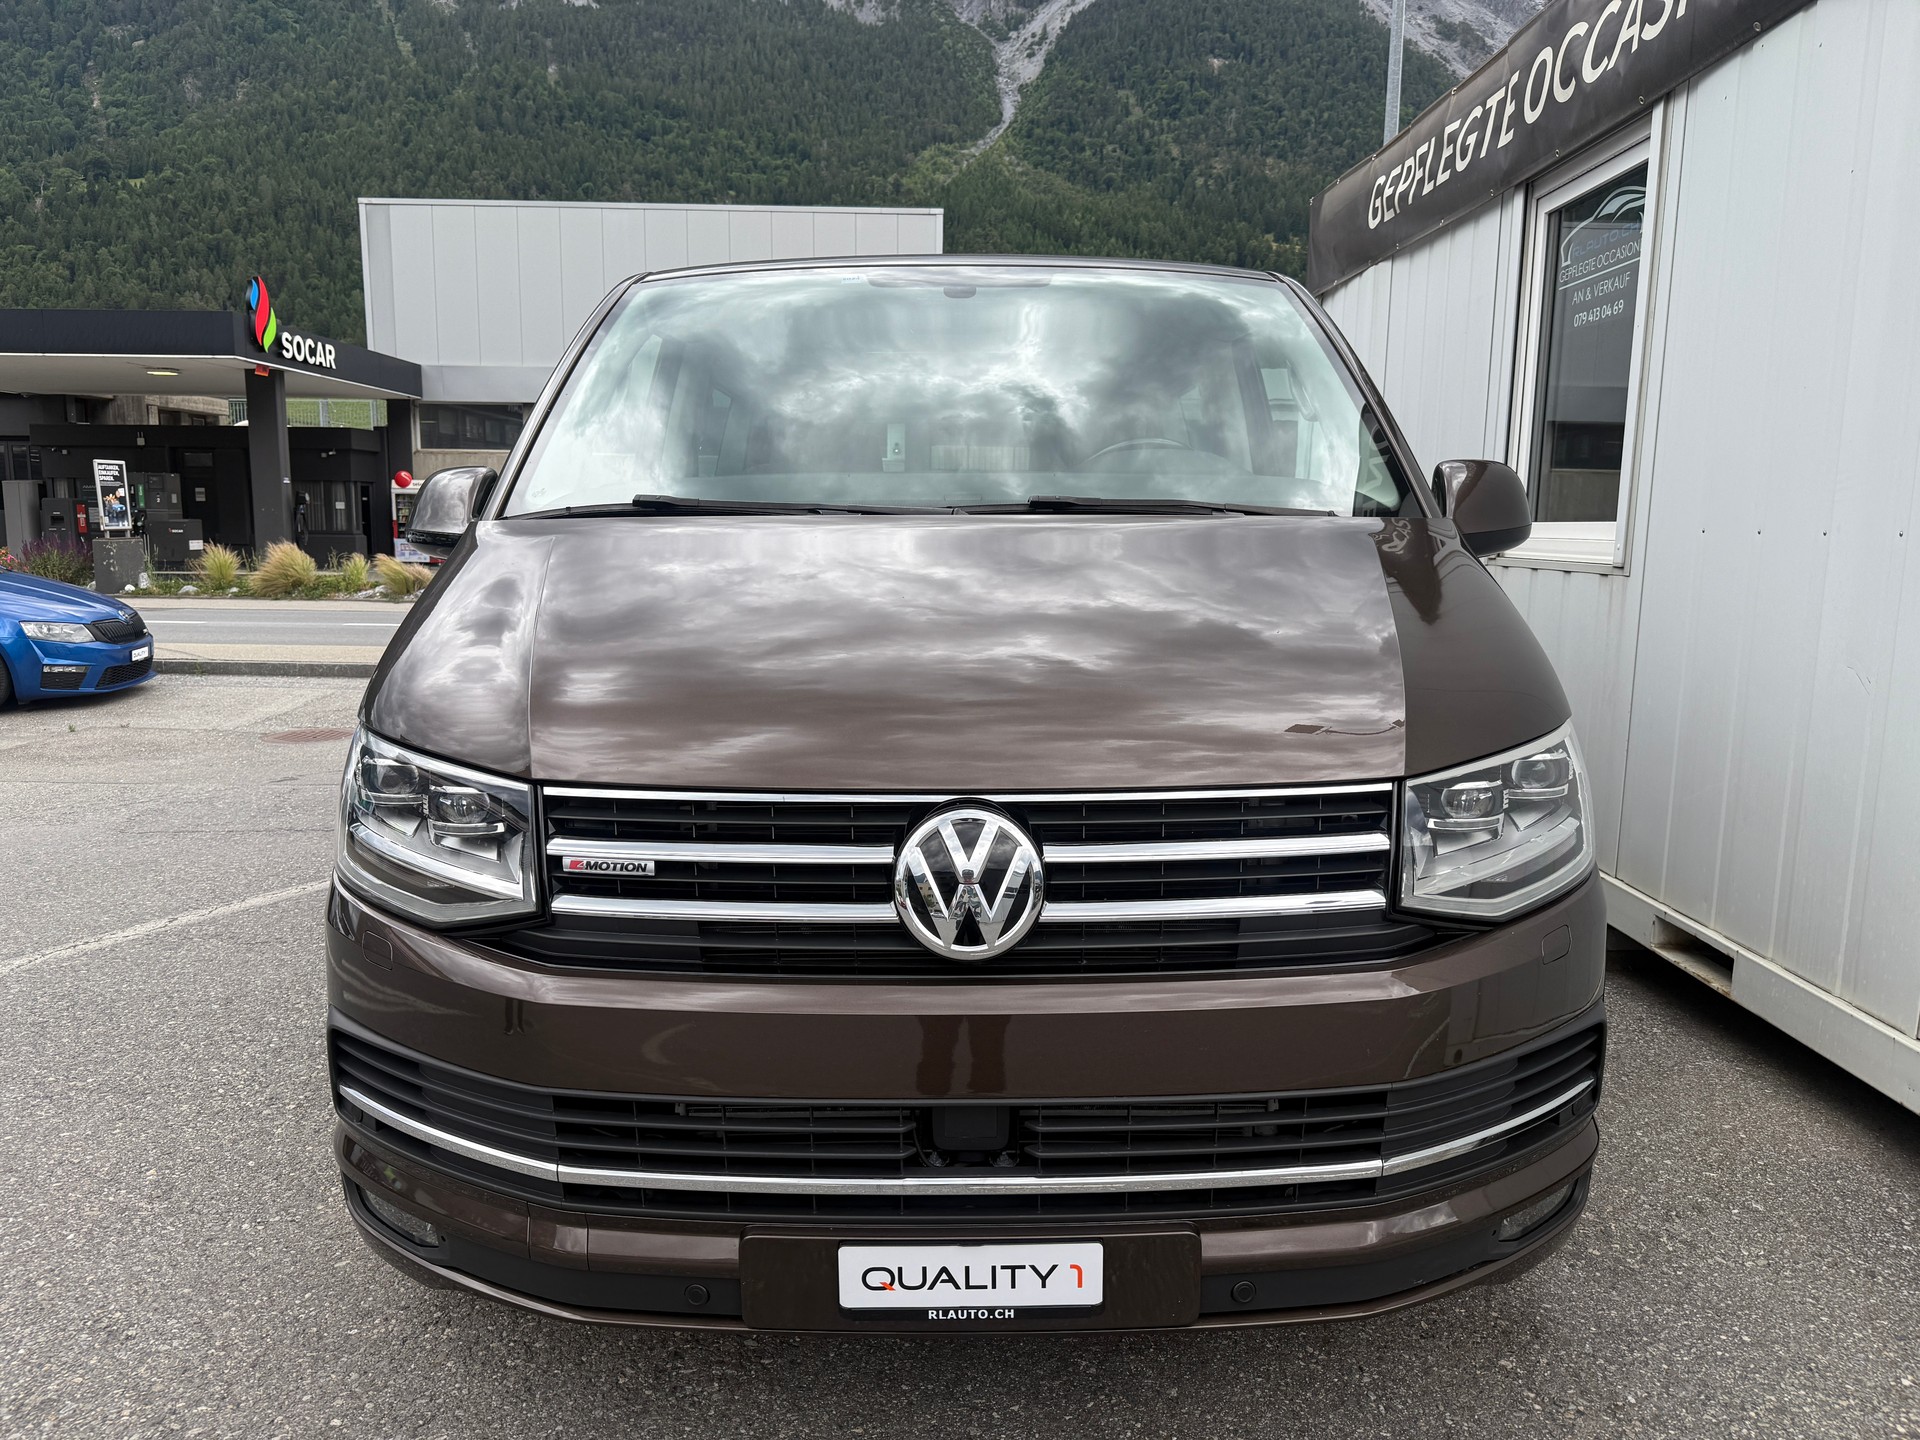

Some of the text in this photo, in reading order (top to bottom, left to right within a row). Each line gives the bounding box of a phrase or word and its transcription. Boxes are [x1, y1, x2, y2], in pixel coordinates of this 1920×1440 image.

[1367, 69, 1520, 230] GEPFLEGTE
[1559, 256, 1597, 283] GEPFLEGTE
[1571, 271, 1631, 306] AN & VERKAUF
[1573, 299, 1624, 328] 079 413 04 69
[281, 331, 337, 370] SOCAR
[861, 1263, 1083, 1292] QUALITY 1
[928, 1309, 1015, 1320] RLAUTO.CH
